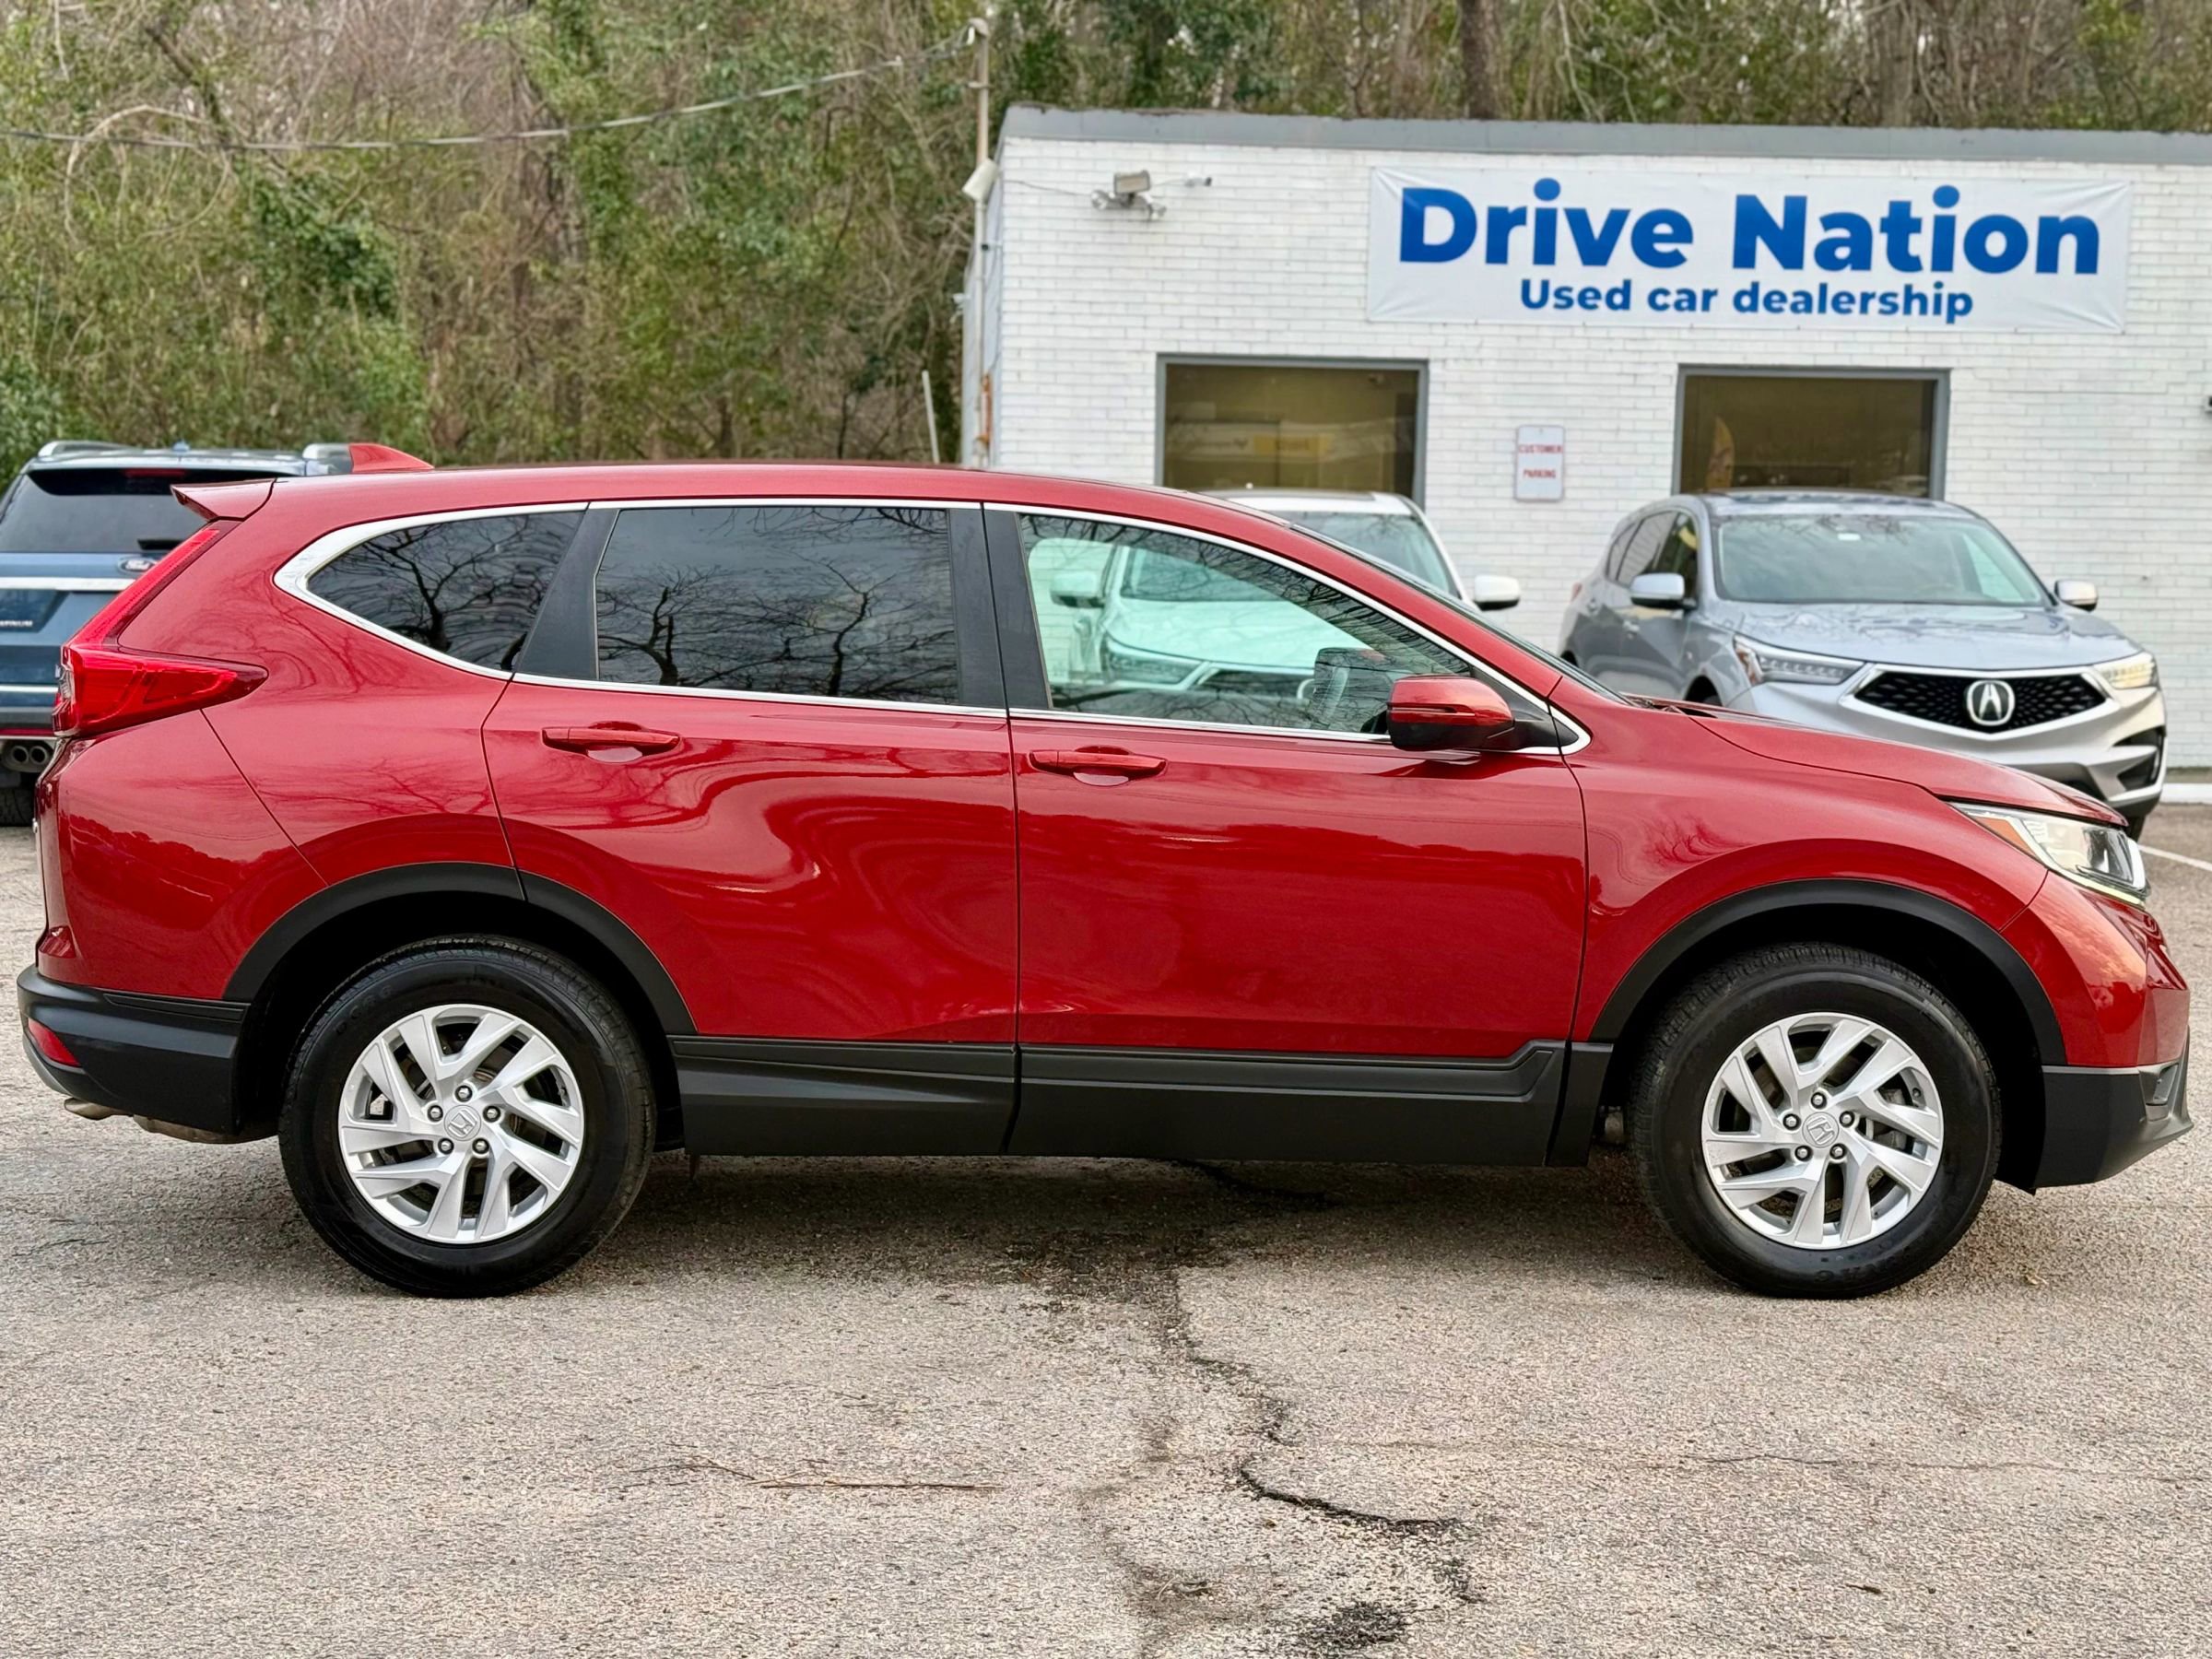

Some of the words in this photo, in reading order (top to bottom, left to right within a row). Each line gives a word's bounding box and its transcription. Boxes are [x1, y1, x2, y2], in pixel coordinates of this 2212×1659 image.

[1399, 178, 1694, 269] Drive
[1732, 185, 2100, 275] Nation
[1521, 279, 1631, 311] Used
[1647, 288, 1718, 312] car
[1733, 281, 1973, 324] dealership
